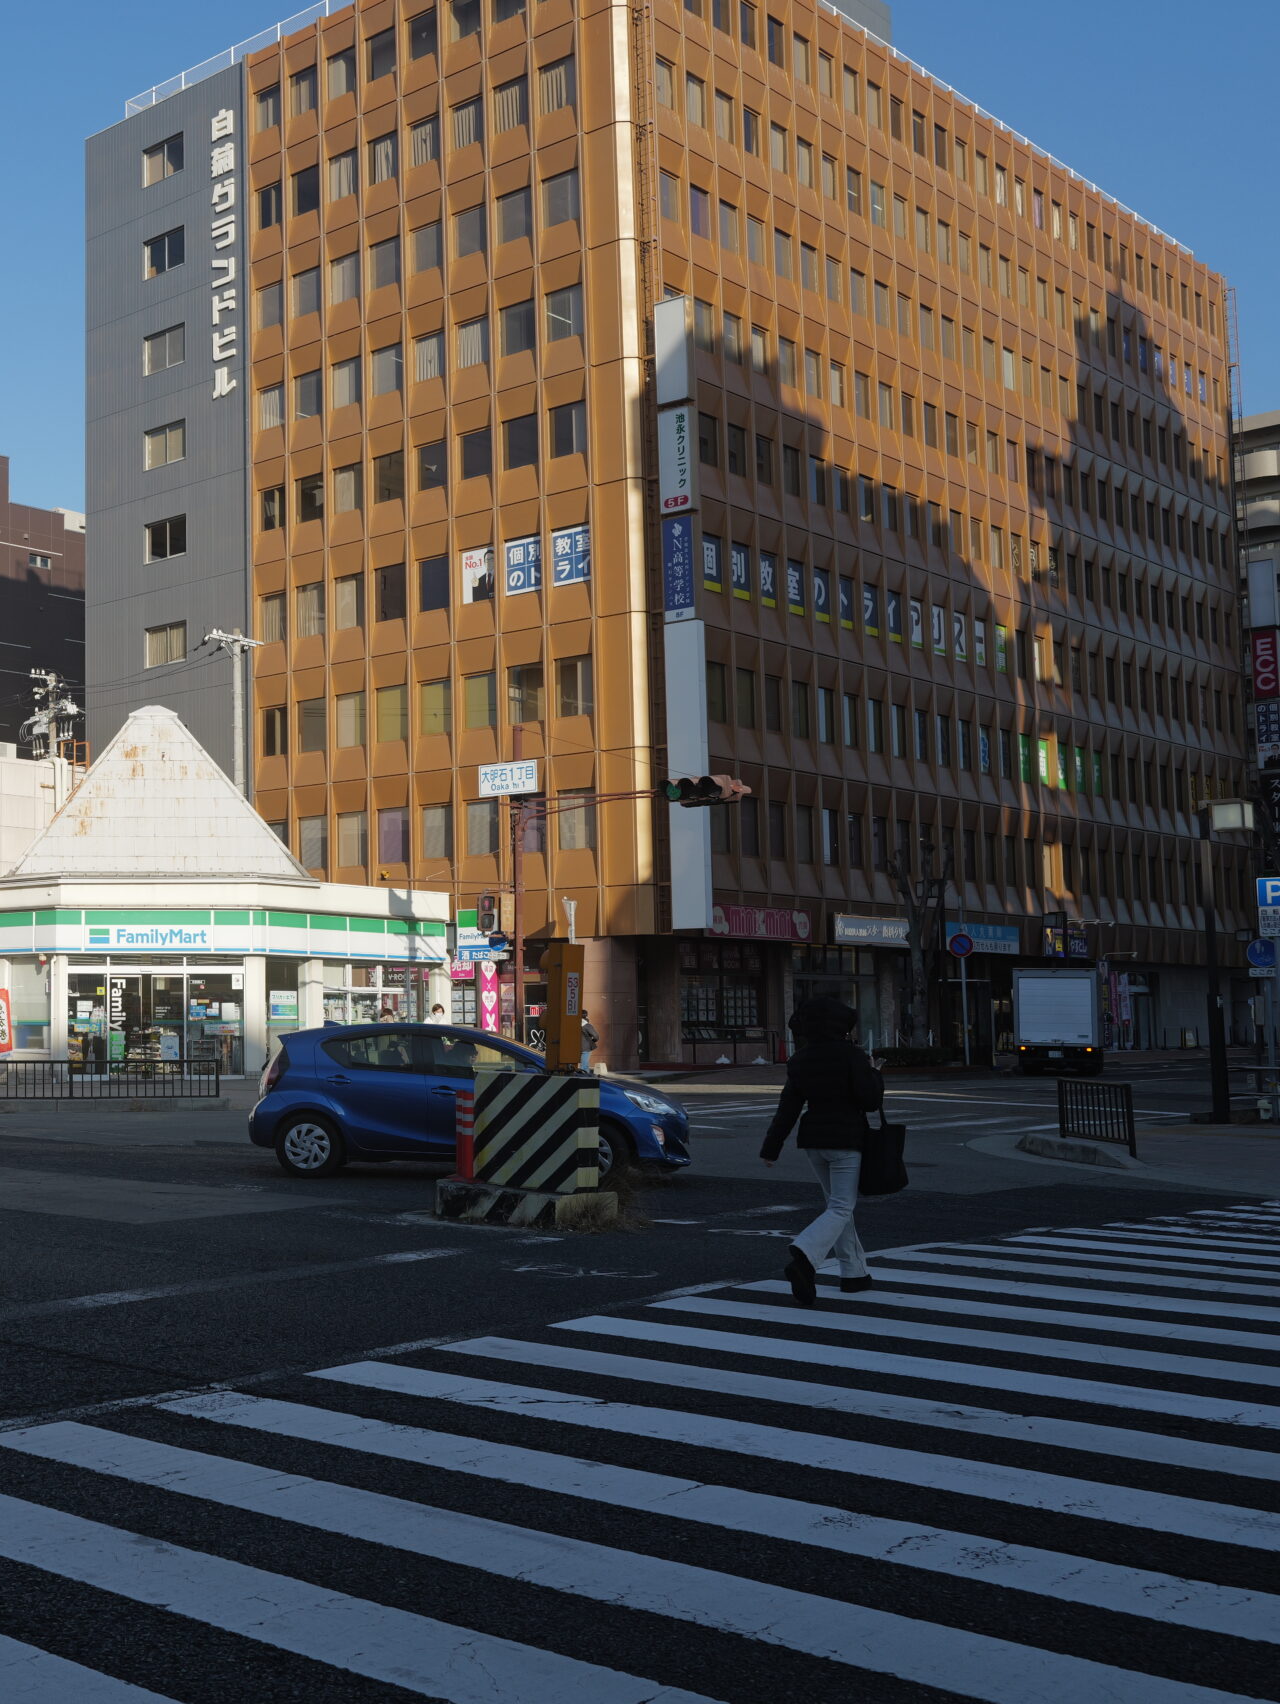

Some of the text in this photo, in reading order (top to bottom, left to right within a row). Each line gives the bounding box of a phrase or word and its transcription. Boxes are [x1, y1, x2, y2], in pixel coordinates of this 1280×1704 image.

[210, 108, 237, 400] 白菊グランドビル
[675, 412, 687, 489] 池永クリニック
[667, 496, 685, 507] 5F
[465, 558, 483, 570] No.1
[672, 538, 685, 605] N高等学校
[1255, 637, 1276, 691] ECC
[1266, 880, 1280, 904] P
[116, 928, 207, 946] FamilyMart
[461, 951, 470, 960] 酒
[568, 977, 579, 988] 53
[570, 988, 576, 999] 5
